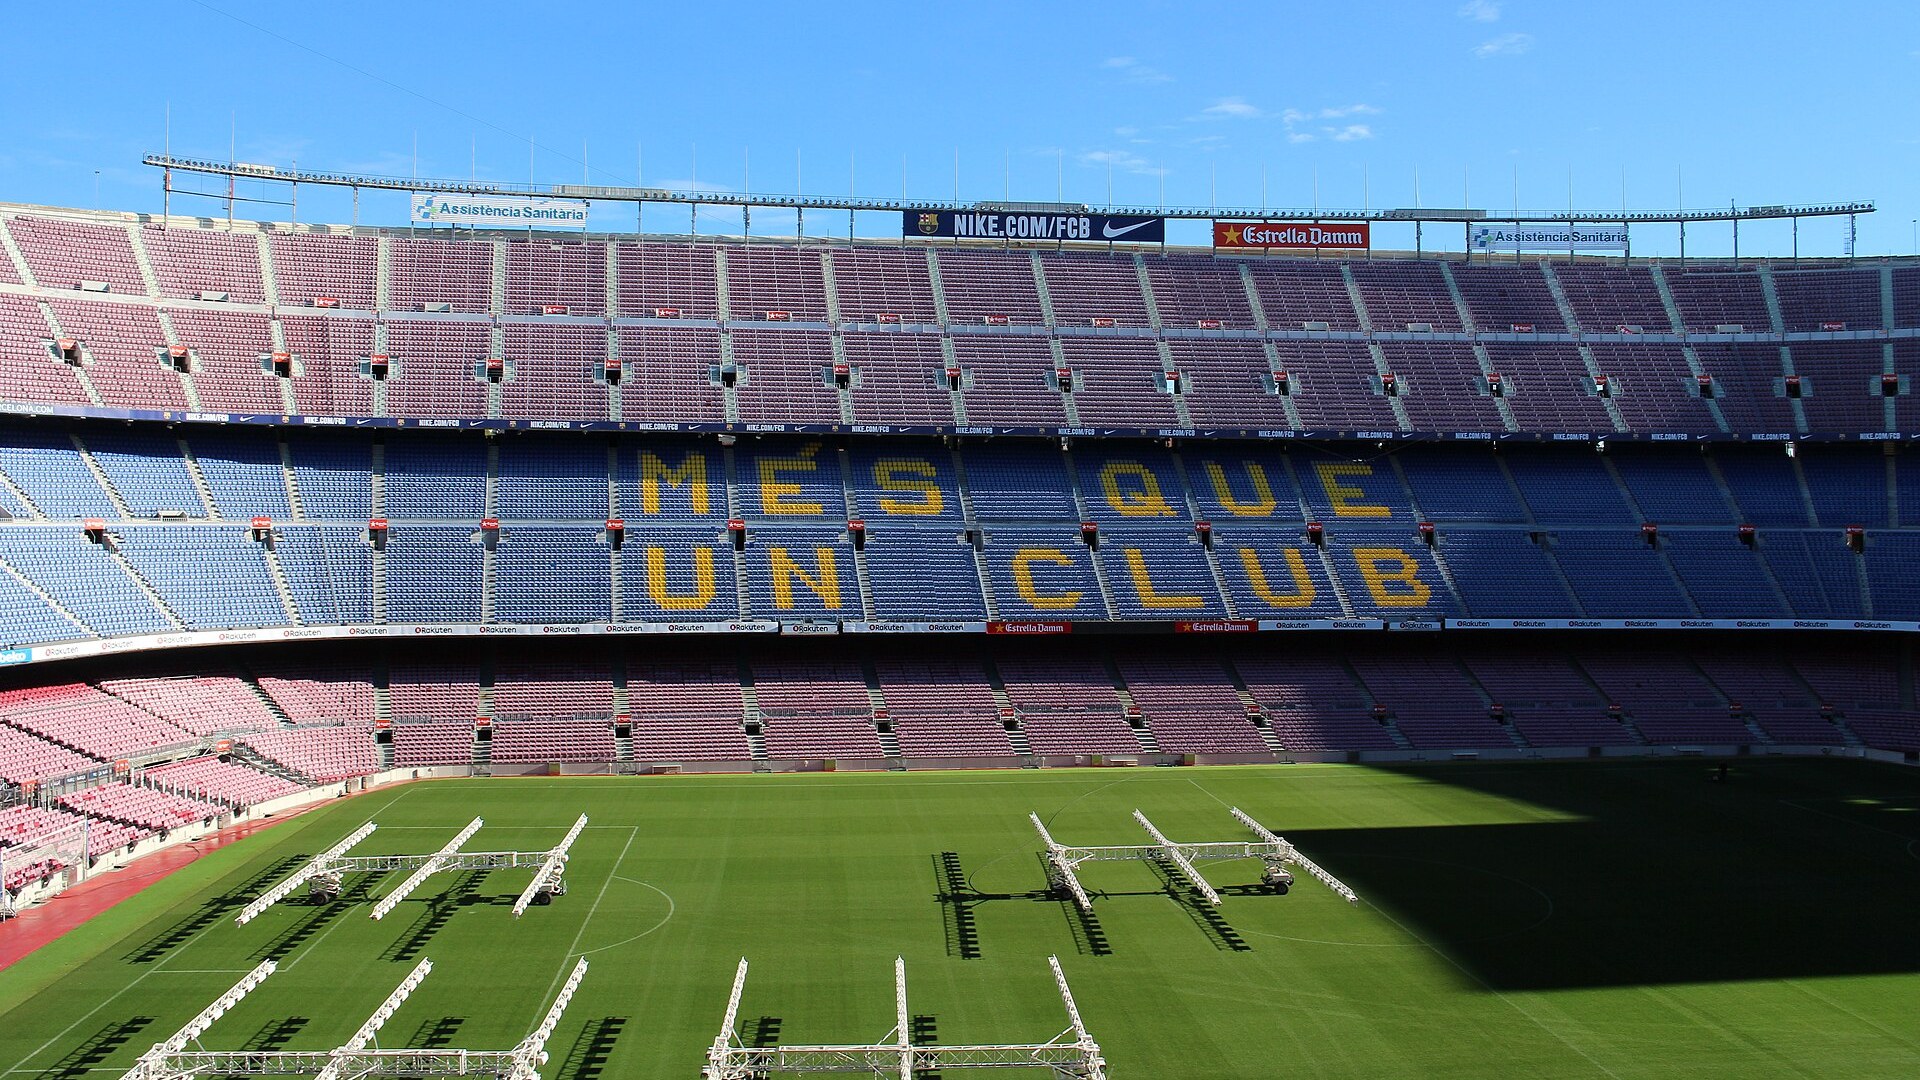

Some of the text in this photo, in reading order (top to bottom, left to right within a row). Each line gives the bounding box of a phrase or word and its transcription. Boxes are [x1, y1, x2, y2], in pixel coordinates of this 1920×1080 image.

[440, 202, 584, 220] Assistència Sanitària
[954, 214, 1090, 238] NIKE.COM/FCB
[1242, 225, 1363, 245] Estrella Damm
[1495, 230, 1628, 243] Assistència Sanitària
[0, 403, 54, 414] CELONA.COM
[186, 413, 229, 422] NIKE.COM/FCB
[304, 417, 346, 425] NIKE.COM/FCB
[419, 419, 459, 427] NIKE.COM/FCB
[531, 421, 570, 429] NIKE.COM/FCB
[640, 423, 678, 431] NIKE.COM/FCB
[747, 424, 784, 432] NIKE.COM/FCB
[852, 425, 889, 433] NIKE.COM/FCB
[1058, 428, 1094, 436] NIKE.COM/FCB
[1159, 429, 1195, 437] NIKE.COM/FCB
[1259, 430, 1294, 438] NIKE.COM/FCB
[1357, 431, 1392, 439] NIKE.COM/FCB
[1456, 432, 1491, 440] NIKE.COM/FCB
[1554, 433, 1588, 441] NIKE.COM/FCB
[1652, 433, 1687, 441] NIKE.COM/FCB
[1752, 433, 1789, 441] NIKE.COM/FCB
[1860, 432, 1900, 441] NIKE.COM/FCB
[640, 442, 1392, 518] MÉS QUE
[648, 548, 1431, 611] UN CLUB
[675, 624, 704, 632] Rakuten
[799, 624, 828, 632] Rakuten
[875, 623, 904, 631] Rakuten
[935, 623, 963, 631] Rakuten
[1006, 623, 1063, 632] Estrella Damm
[1193, 622, 1249, 632] Estrella Damm
[1282, 621, 1309, 629] Rakuten
[1405, 621, 1432, 629] Rakuten
[1462, 620, 1490, 628] Rakuten
[1519, 620, 1546, 628] Rakuten
[1574, 620, 1601, 628] Rakuten
[1630, 620, 1657, 628] Rakuten
[1686, 620, 1713, 628] Rakuten
[1742, 620, 1770, 628] Rakuten
[1799, 620, 1828, 628] Rakuten
[1860, 621, 1891, 629] Rakuten
[290, 629, 322, 637] Rakuten
[356, 626, 388, 634] Rakuten
[225, 631, 256, 640] Rakuten
